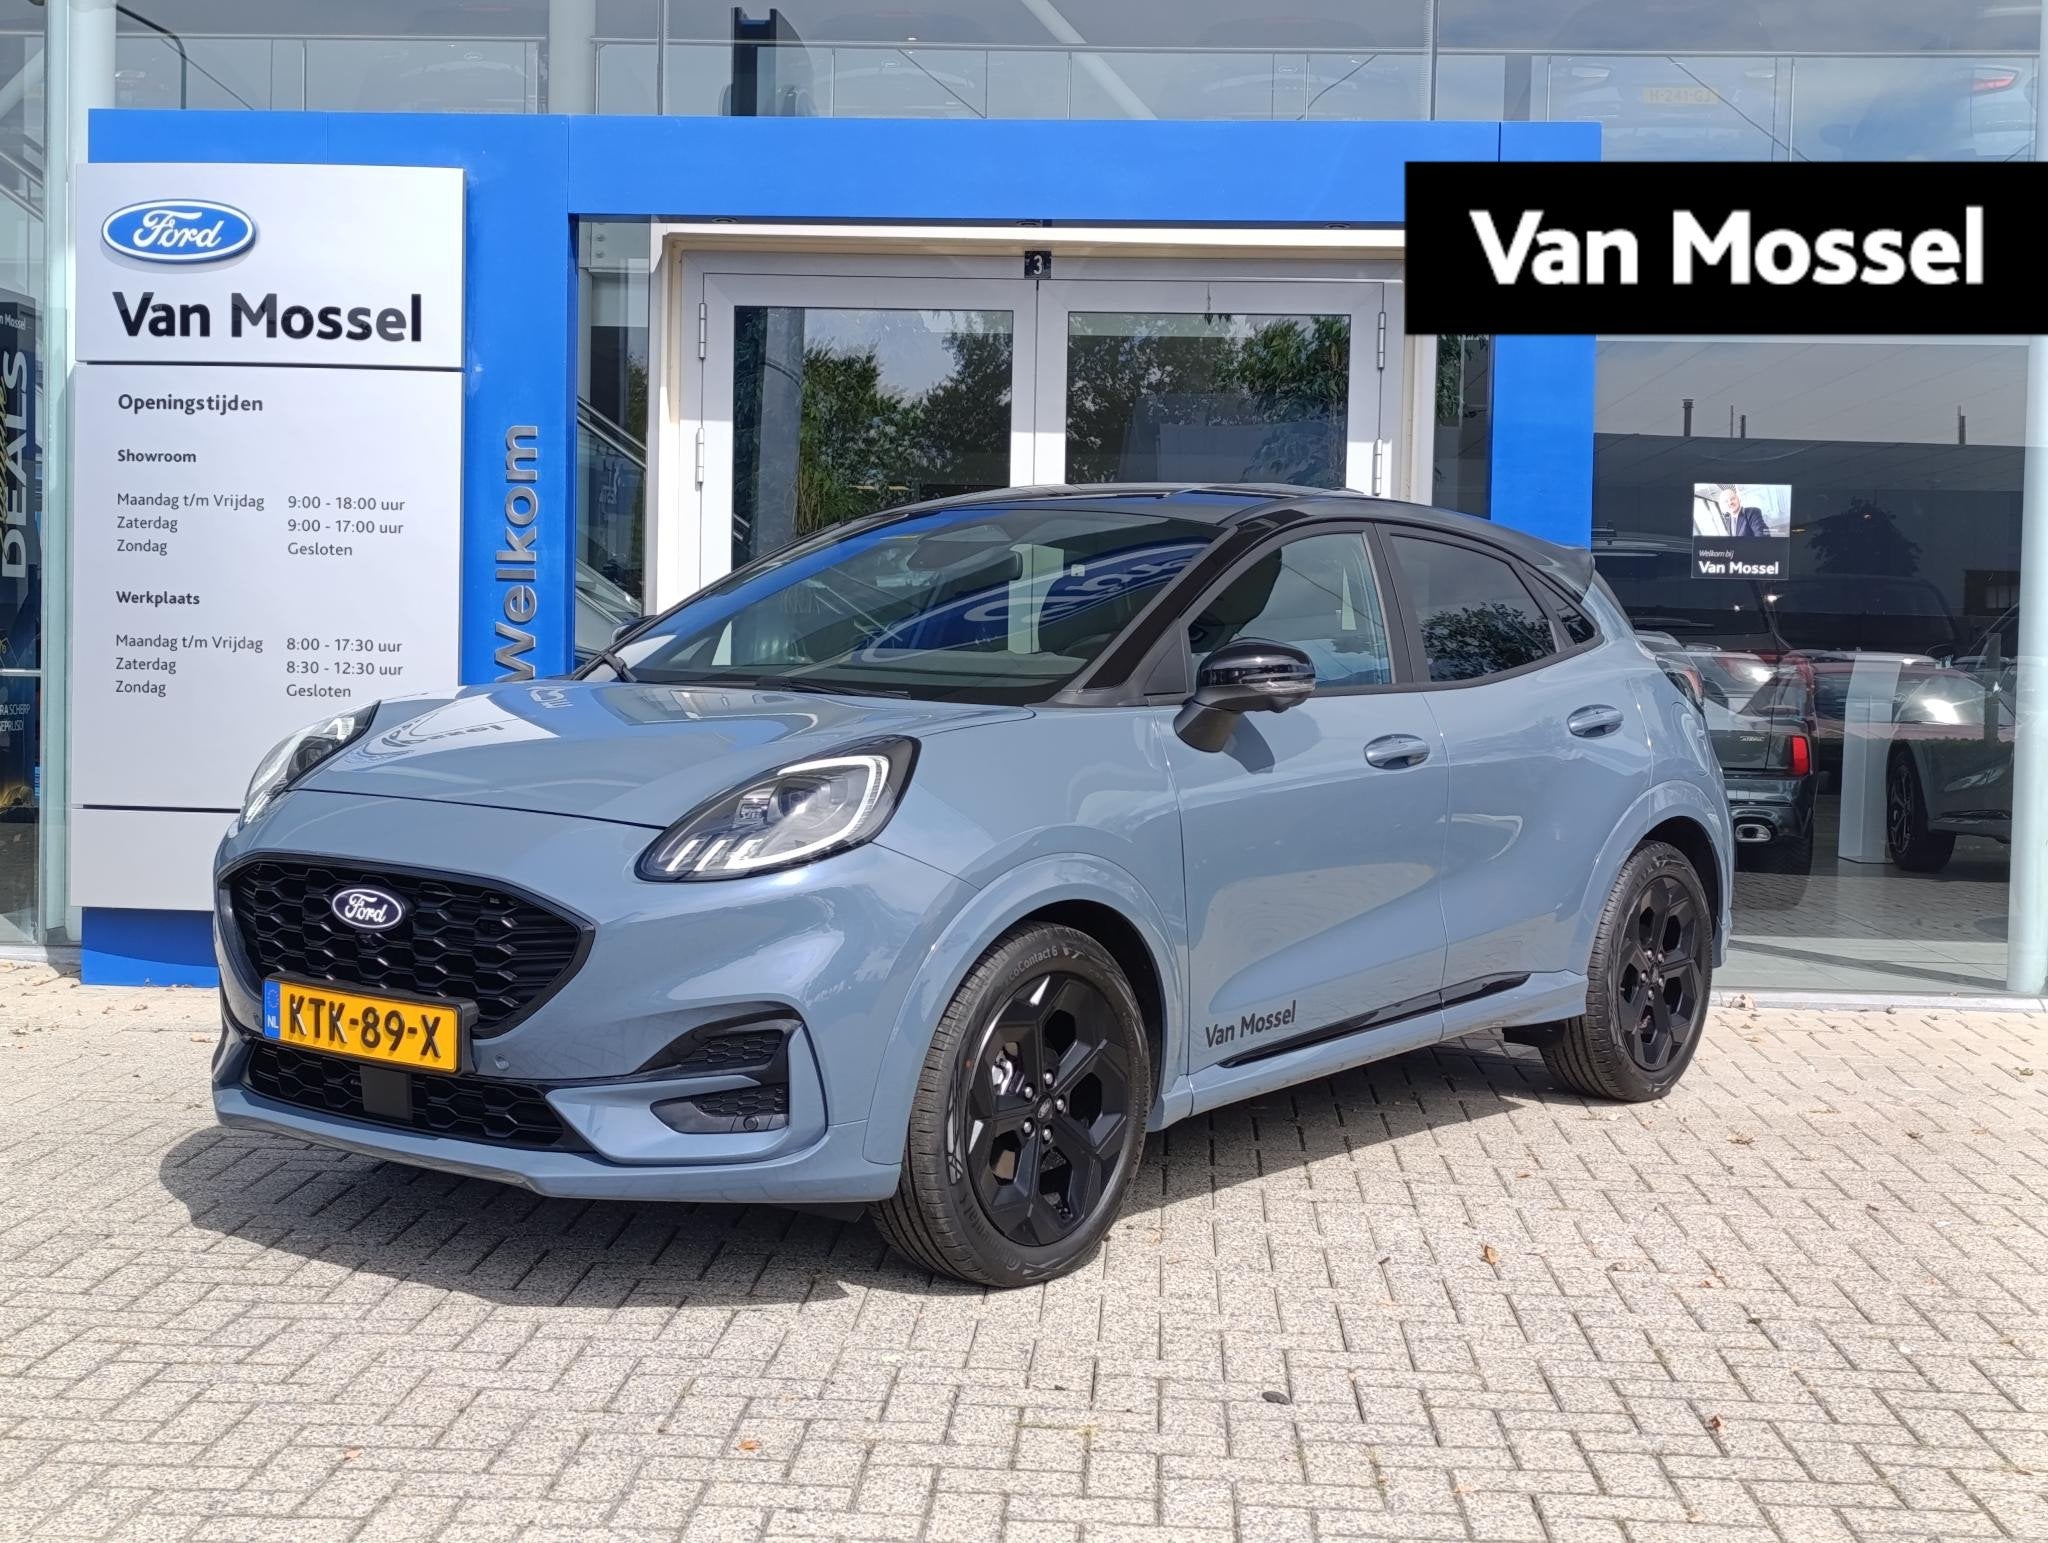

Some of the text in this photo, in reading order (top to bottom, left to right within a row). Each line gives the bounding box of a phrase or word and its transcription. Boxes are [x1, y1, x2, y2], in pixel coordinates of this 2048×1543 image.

[132, 208, 223, 250] Ford
[1034, 254, 1043, 275] 3
[5, 312, 26, 330] Mossel
[112, 291, 422, 342] Van Mossel
[118, 393, 263, 415] Openingstijden
[2, 350, 28, 578] DEALS
[117, 449, 197, 463] Showroom
[117, 493, 180, 510] Maandag
[183, 494, 209, 507] t/m
[213, 494, 265, 511] Vrijdag
[288, 496, 321, 509] 9:00
[336, 497, 377, 510] 18:00
[381, 500, 406, 511] uur
[117, 516, 178, 533] Zaterdag
[288, 519, 321, 532] 9:00
[336, 520, 375, 533] 17:00
[380, 523, 404, 534] uur
[117, 539, 353, 556] Zondag Gesloten
[495, 425, 539, 682] Welkom
[1698, 550, 1725, 558] Welkom
[1698, 560, 1779, 575] Van Mossel
[116, 591, 200, 607] Werkplaats
[116, 634, 178, 652] Maandag
[182, 635, 208, 649] t/m
[212, 636, 264, 653] Vrijdag
[287, 638, 320, 651] 8:00
[335, 639, 374, 652] 17:30
[379, 641, 403, 653] uur
[116, 657, 177, 674] Zaterdag
[286, 661, 319, 674] 8:30
[335, 662, 375, 675] 12:30
[379, 664, 404, 676] uur
[116, 680, 351, 698] Zondag Gesloten
[344, 893, 388, 923] Ford
[267, 1014, 279, 1030] NL
[289, 993, 442, 1059] KTK-89-X
[1205, 1000, 1296, 1048] Van Mossel
